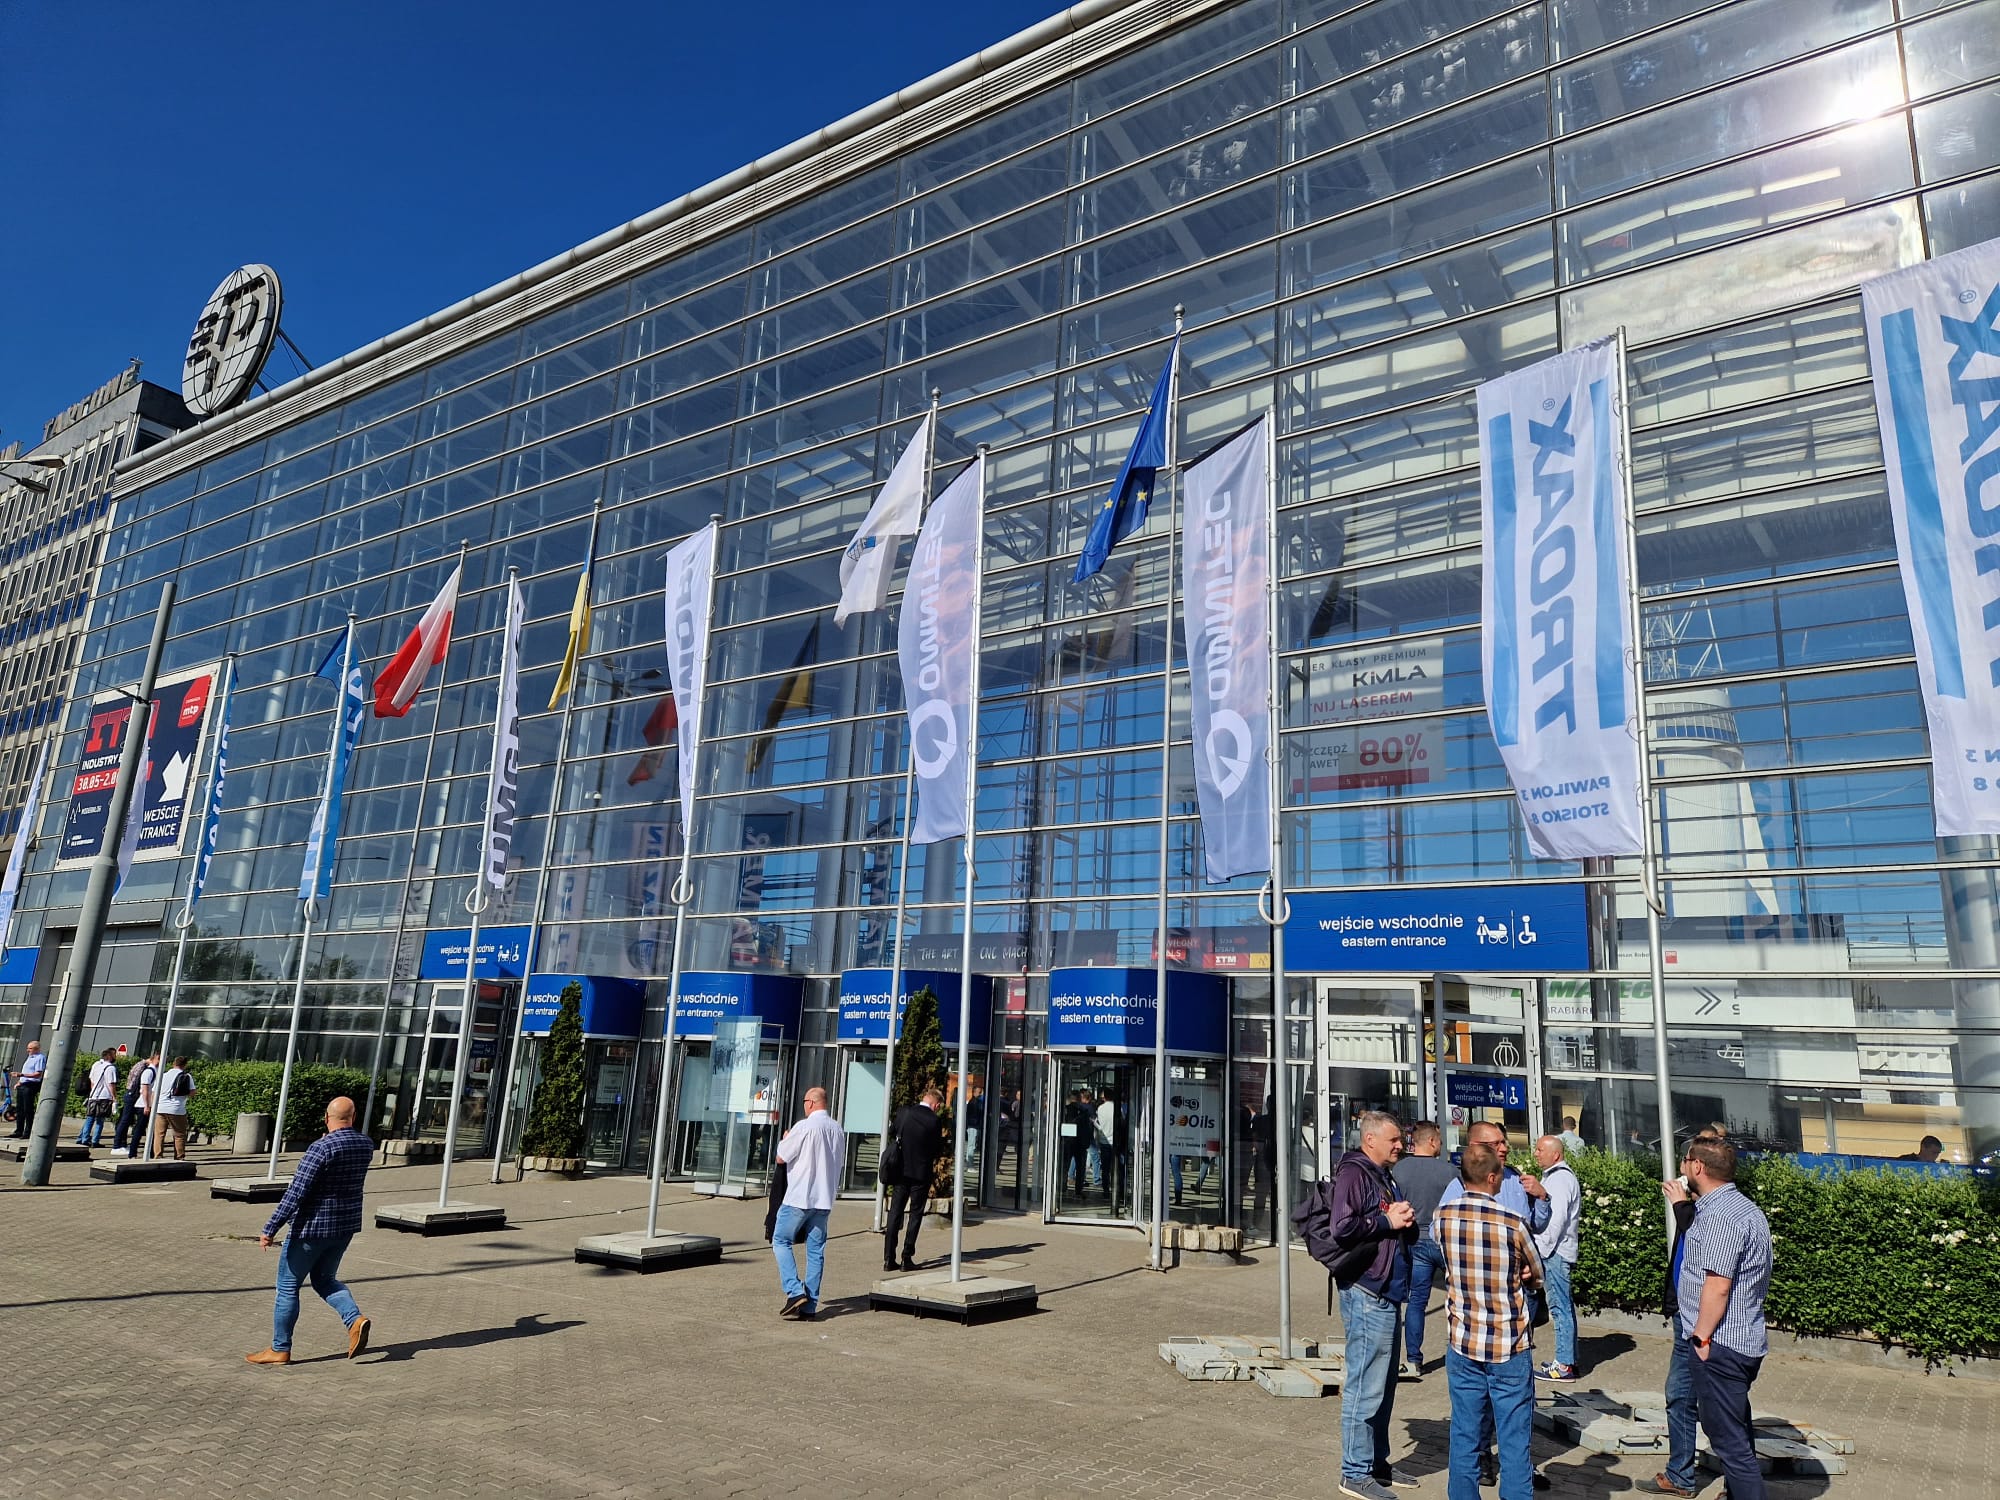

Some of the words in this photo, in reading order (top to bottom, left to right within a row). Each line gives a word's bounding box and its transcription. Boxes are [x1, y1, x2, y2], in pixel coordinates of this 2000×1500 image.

[1331, 656, 1367, 669] KLASY
[1373, 648, 1427, 664] PREMIUM
[1311, 701, 1336, 713] NIJ
[1340, 691, 1413, 710] LASEREM
[1359, 732, 1427, 766] 80%
[81, 753, 119, 771] INDUSTRY
[1310, 758, 1340, 769] AWET
[143, 805, 181, 823] WEJŚCIE
[139, 822, 177, 841] NTRANCE
[1318, 915, 1375, 934] wejście
[1378, 913, 1464, 930] wschodnie
[1341, 935, 1387, 948] eastern
[1390, 935, 1447, 947] entrance
[917, 947, 936, 960] THE
[941, 947, 959, 959] ART
[979, 946, 997, 960] CNC
[532, 992, 561, 1003] wscho
[682, 992, 739, 1005] wschodnie
[1085, 992, 1159, 1009] wschodnie
[687, 1009, 724, 1018] entrance
[1060, 1012, 1091, 1024] eastern
[1093, 1012, 1145, 1025] entrance
[1454, 1082, 1484, 1094] wejście
[1454, 1093, 1485, 1103] entrance
